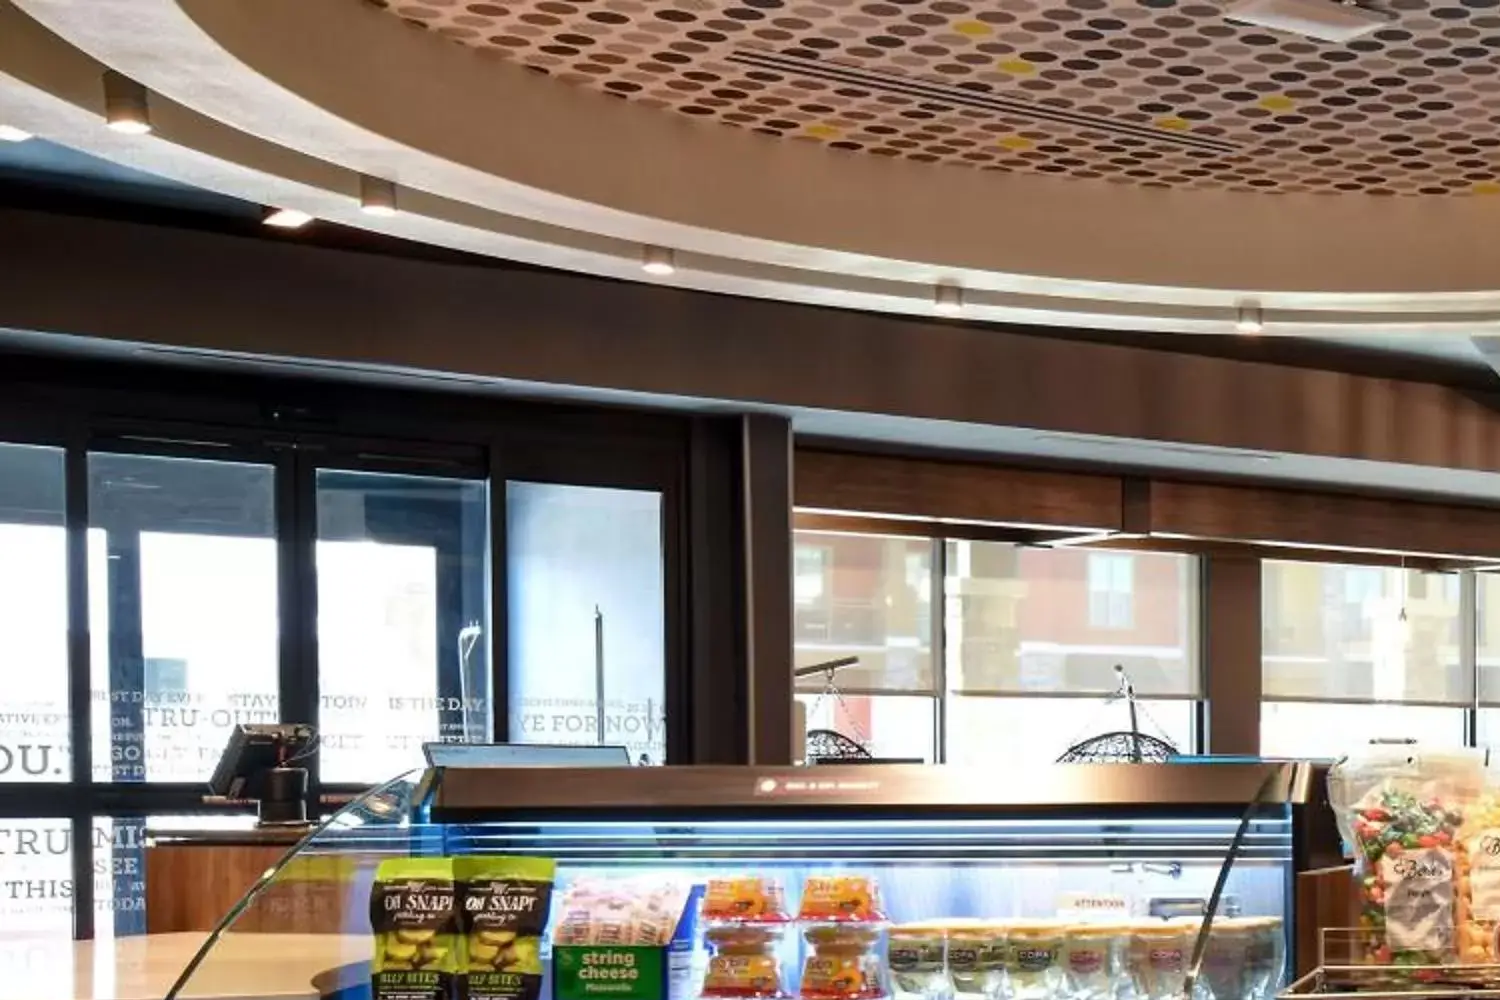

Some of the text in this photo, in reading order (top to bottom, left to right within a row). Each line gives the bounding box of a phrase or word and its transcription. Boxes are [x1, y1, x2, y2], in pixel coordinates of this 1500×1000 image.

[322, 695, 367, 709] TODA
[551, 714, 598, 734] FOR
[605, 714, 664, 734] NOW
[94, 857, 138, 875] SEE
[5, 879, 74, 899] THIS
[582, 951, 635, 967] string
[578, 966, 639, 980] cheese
